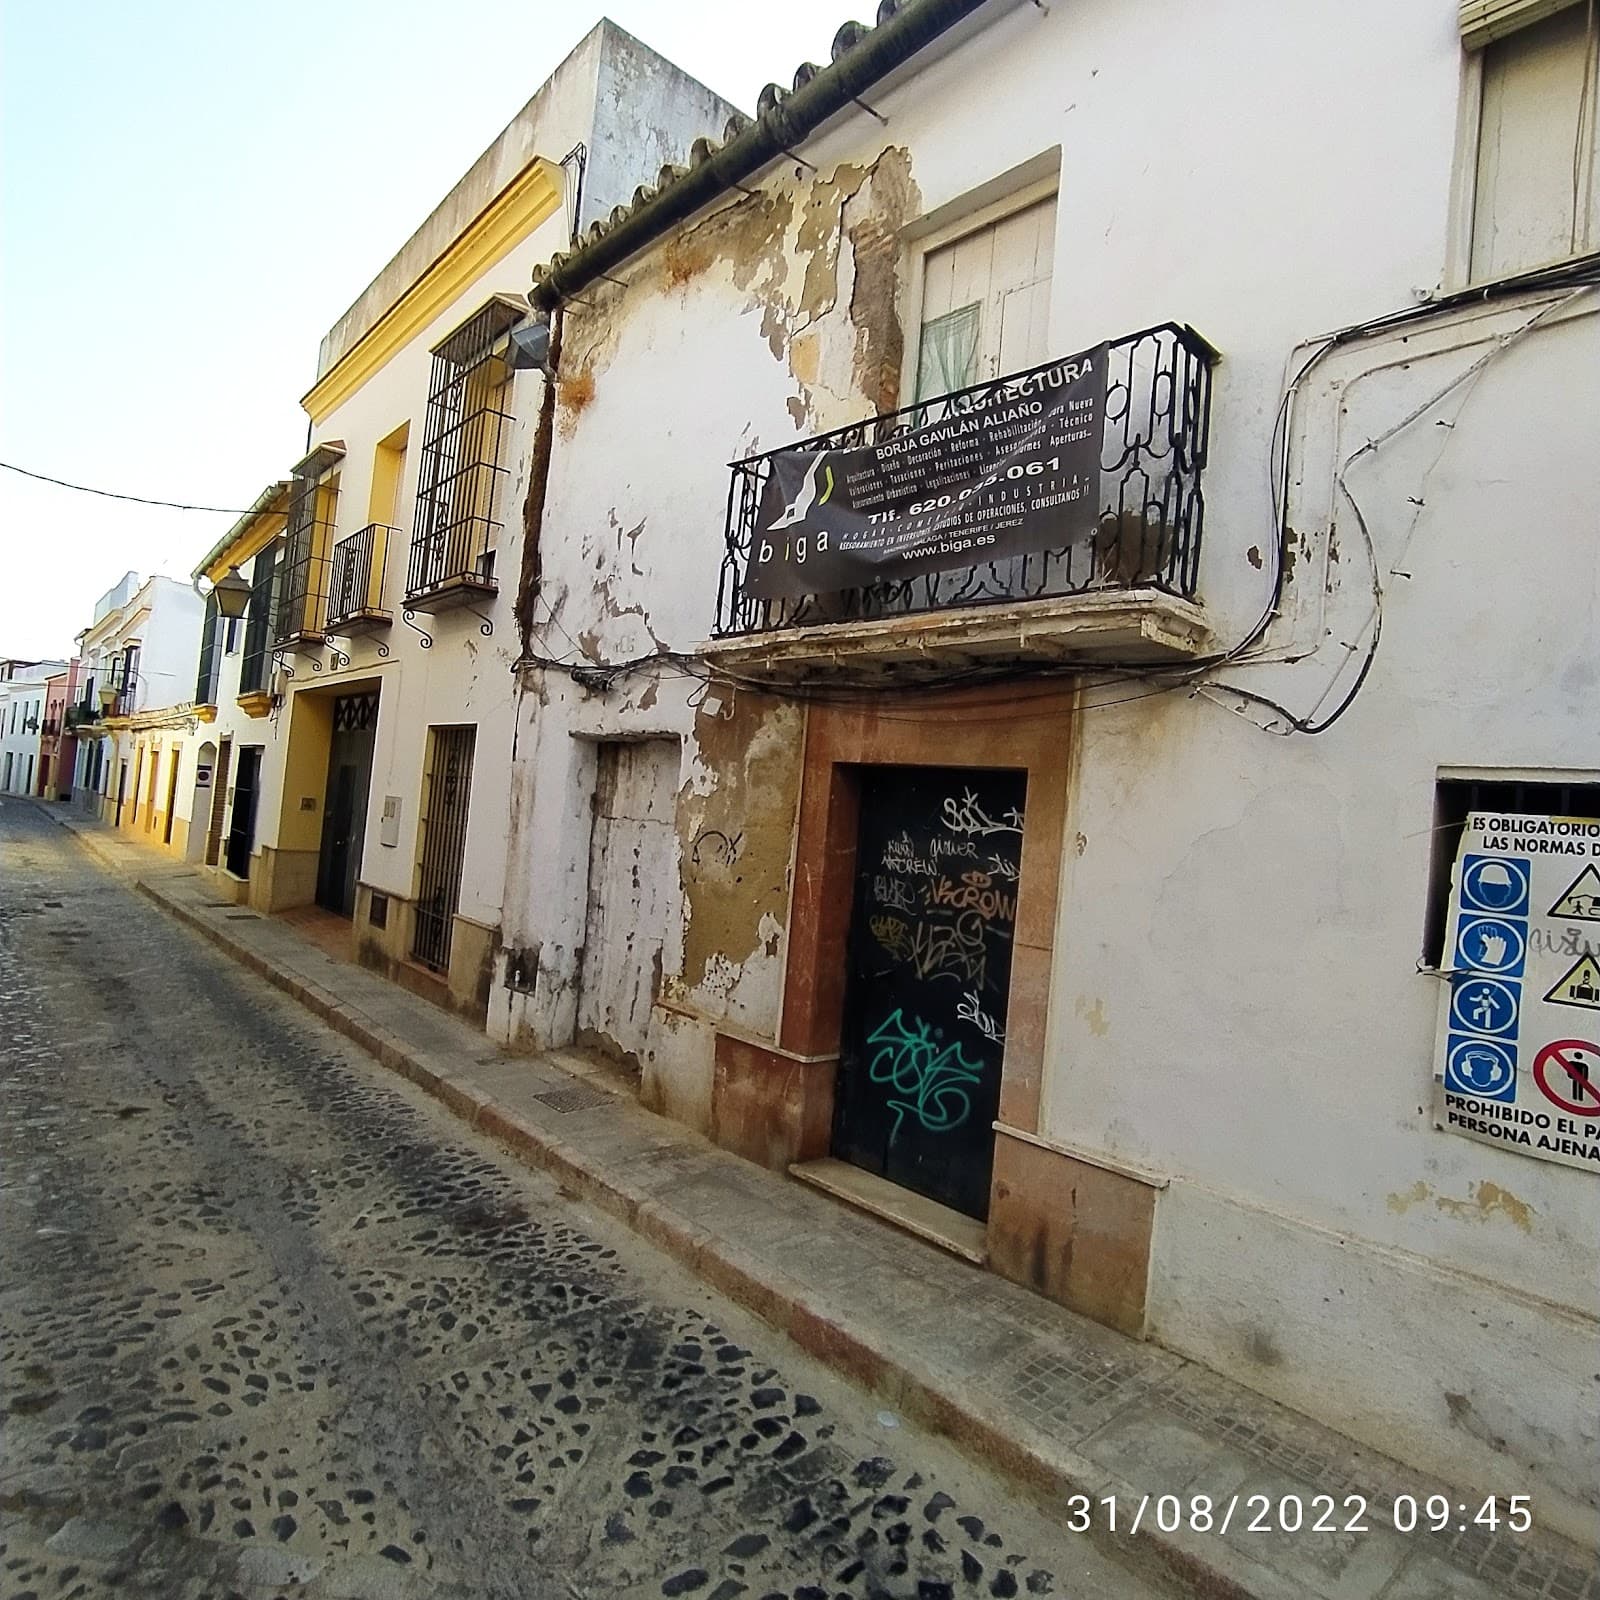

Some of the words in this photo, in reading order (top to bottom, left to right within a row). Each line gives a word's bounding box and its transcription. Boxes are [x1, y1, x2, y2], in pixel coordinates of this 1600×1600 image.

[876, 438, 917, 460] BORJA
[920, 418, 979, 446] GAVILÁN
[983, 401, 1042, 428] ALIAÑO
[907, 448, 942, 465] Decoración
[950, 438, 979, 452] Reforma
[1069, 398, 1093, 411] Nueva
[890, 467, 926, 484] Tasaciones
[935, 452, 983, 472] Peritaciones
[1060, 413, 1093, 429] Técnico
[868, 509, 901, 525] Tlf.
[949, 525, 989, 538] TENERIFE
[995, 518, 1024, 530] JEREZ
[965, 512, 974, 524] DE
[902, 535, 996, 560] www.biga.es
[1473, 817, 1485, 830] ES
[1489, 818, 1600, 836] OBLIGATORIO
[1483, 836, 1508, 850] LAS
[1514, 838, 1586, 856] NORMAS
[1445, 1094, 1550, 1129] PROHIBIDO
[1557, 1118, 1578, 1135] EL
[1449, 1111, 1531, 1146] PERSONA
[1537, 1135, 1600, 1162] AJENA
